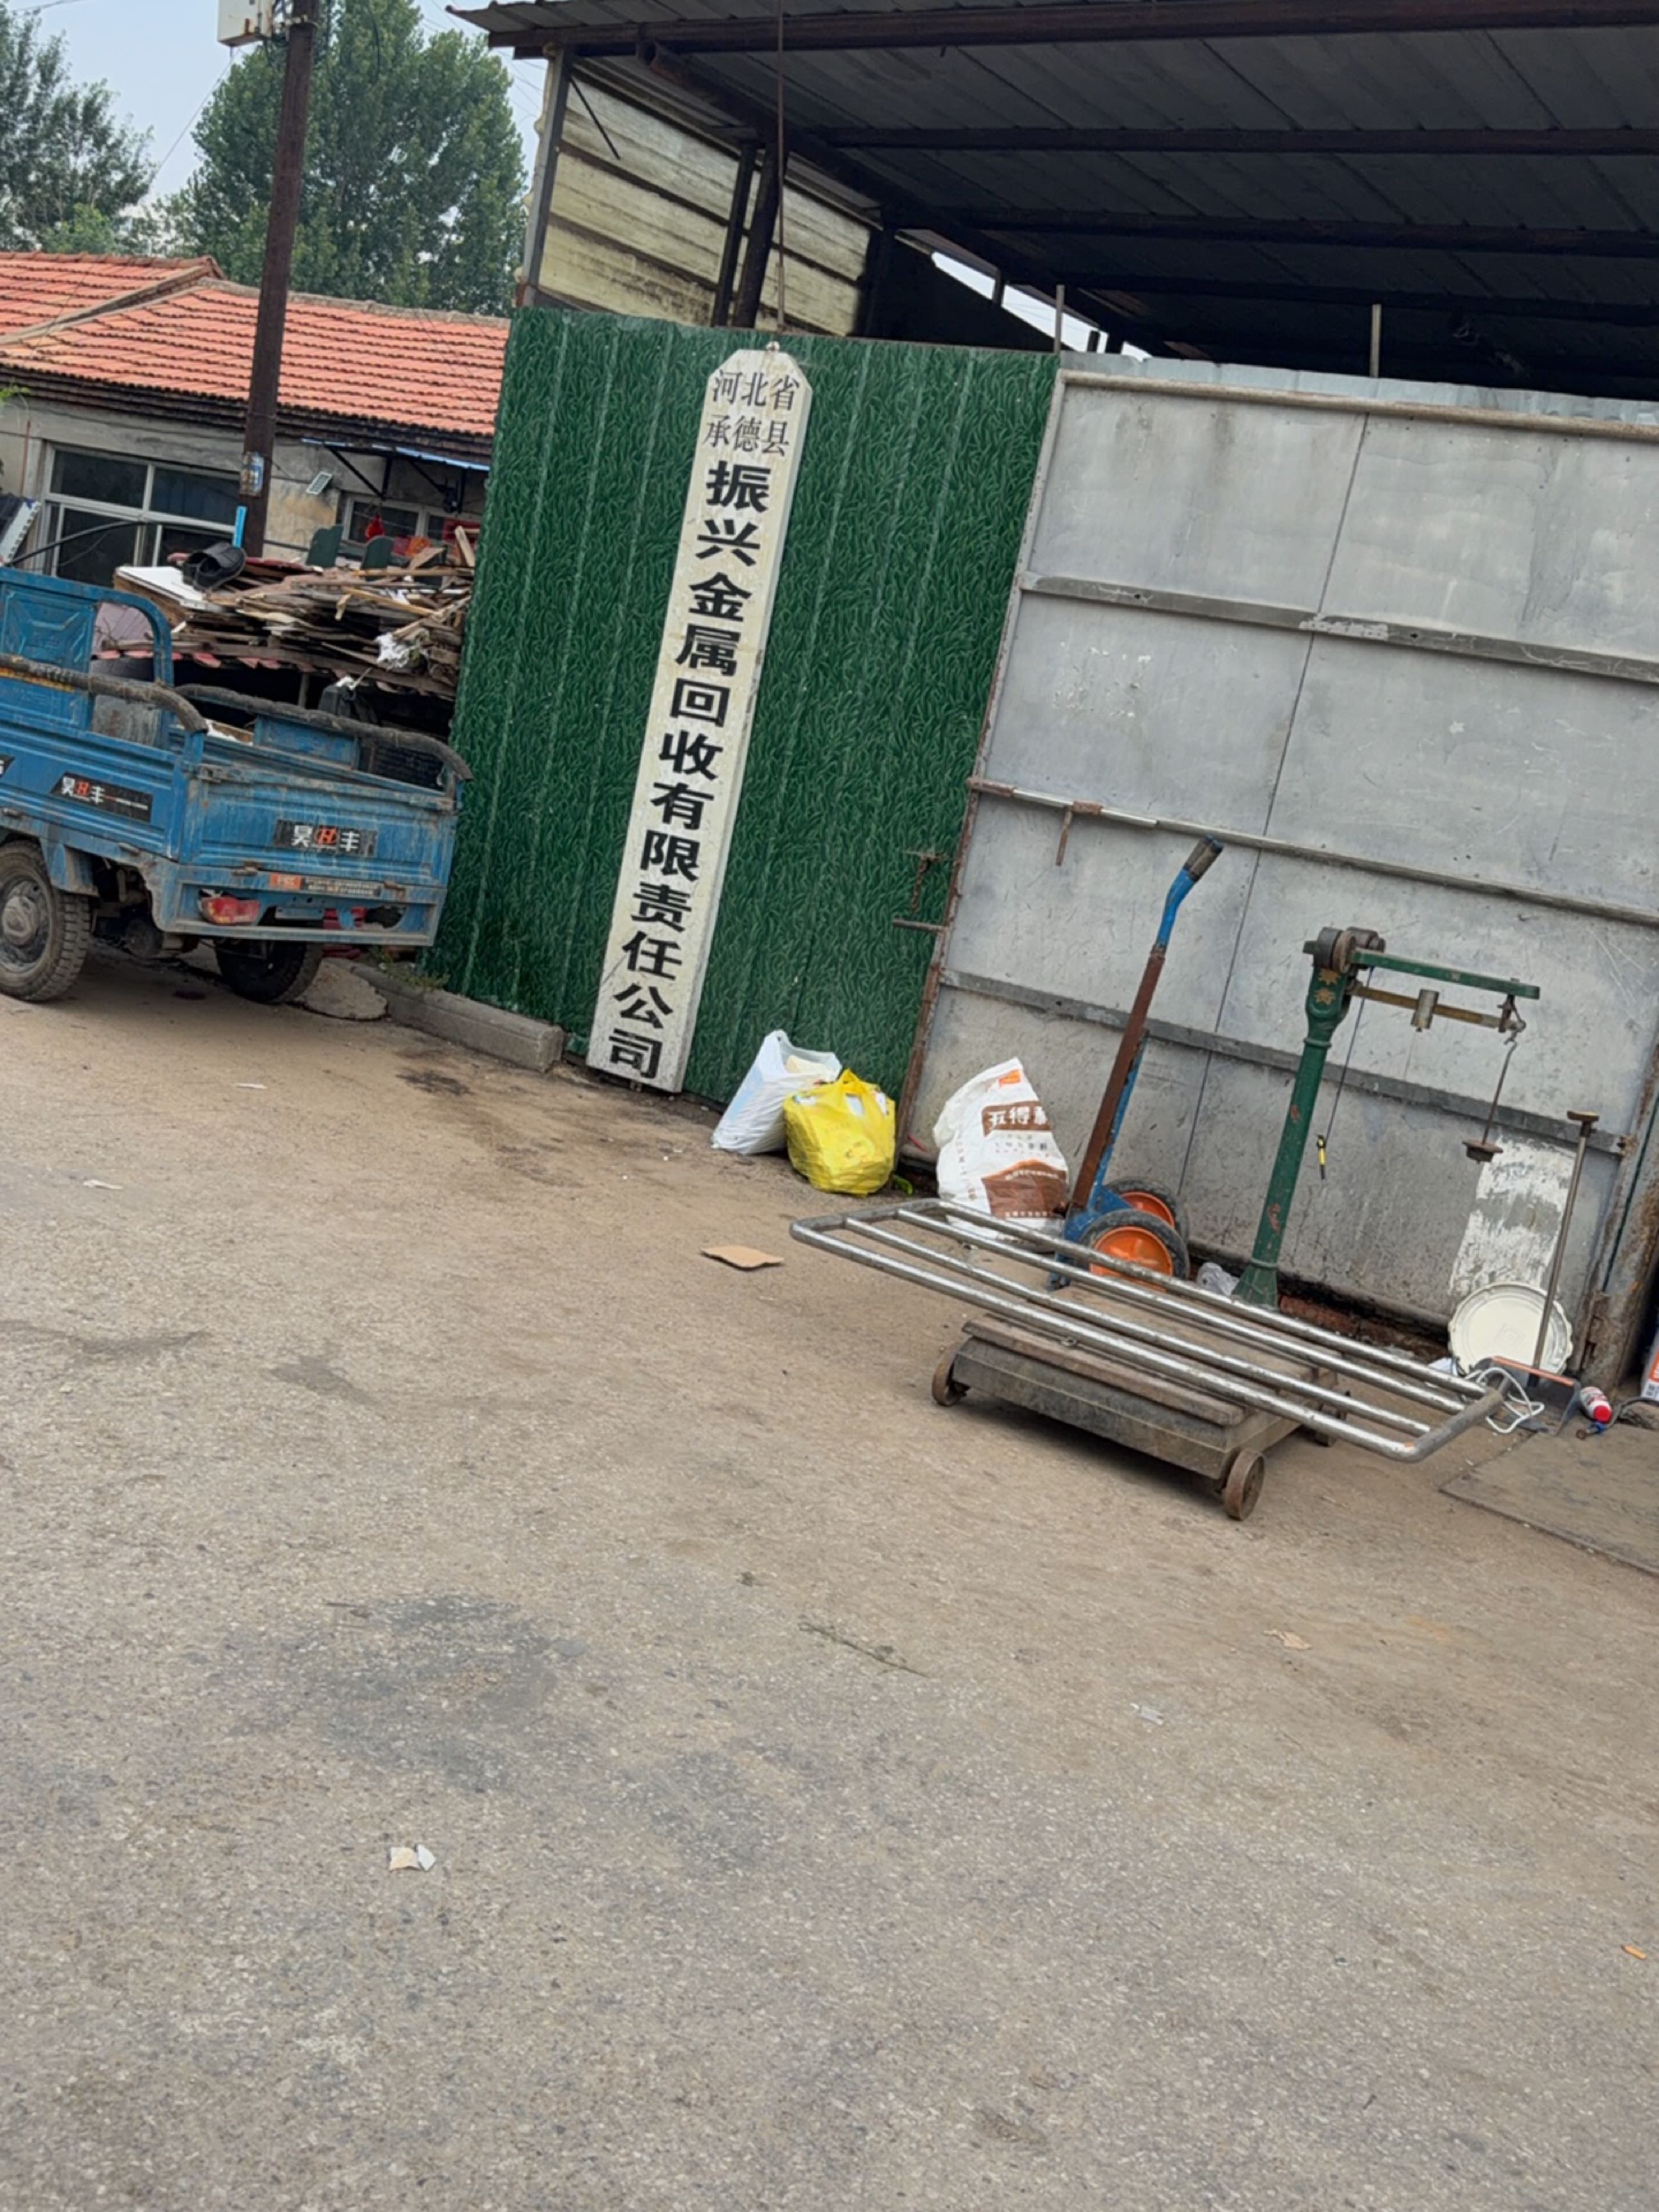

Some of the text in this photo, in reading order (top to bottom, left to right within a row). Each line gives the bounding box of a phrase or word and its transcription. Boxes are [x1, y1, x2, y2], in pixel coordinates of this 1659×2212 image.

[712, 369, 799, 412] 河北省
[702, 414, 789, 457] 承德县
[608, 460, 772, 1080] 振兴金属回收有限责任公司
